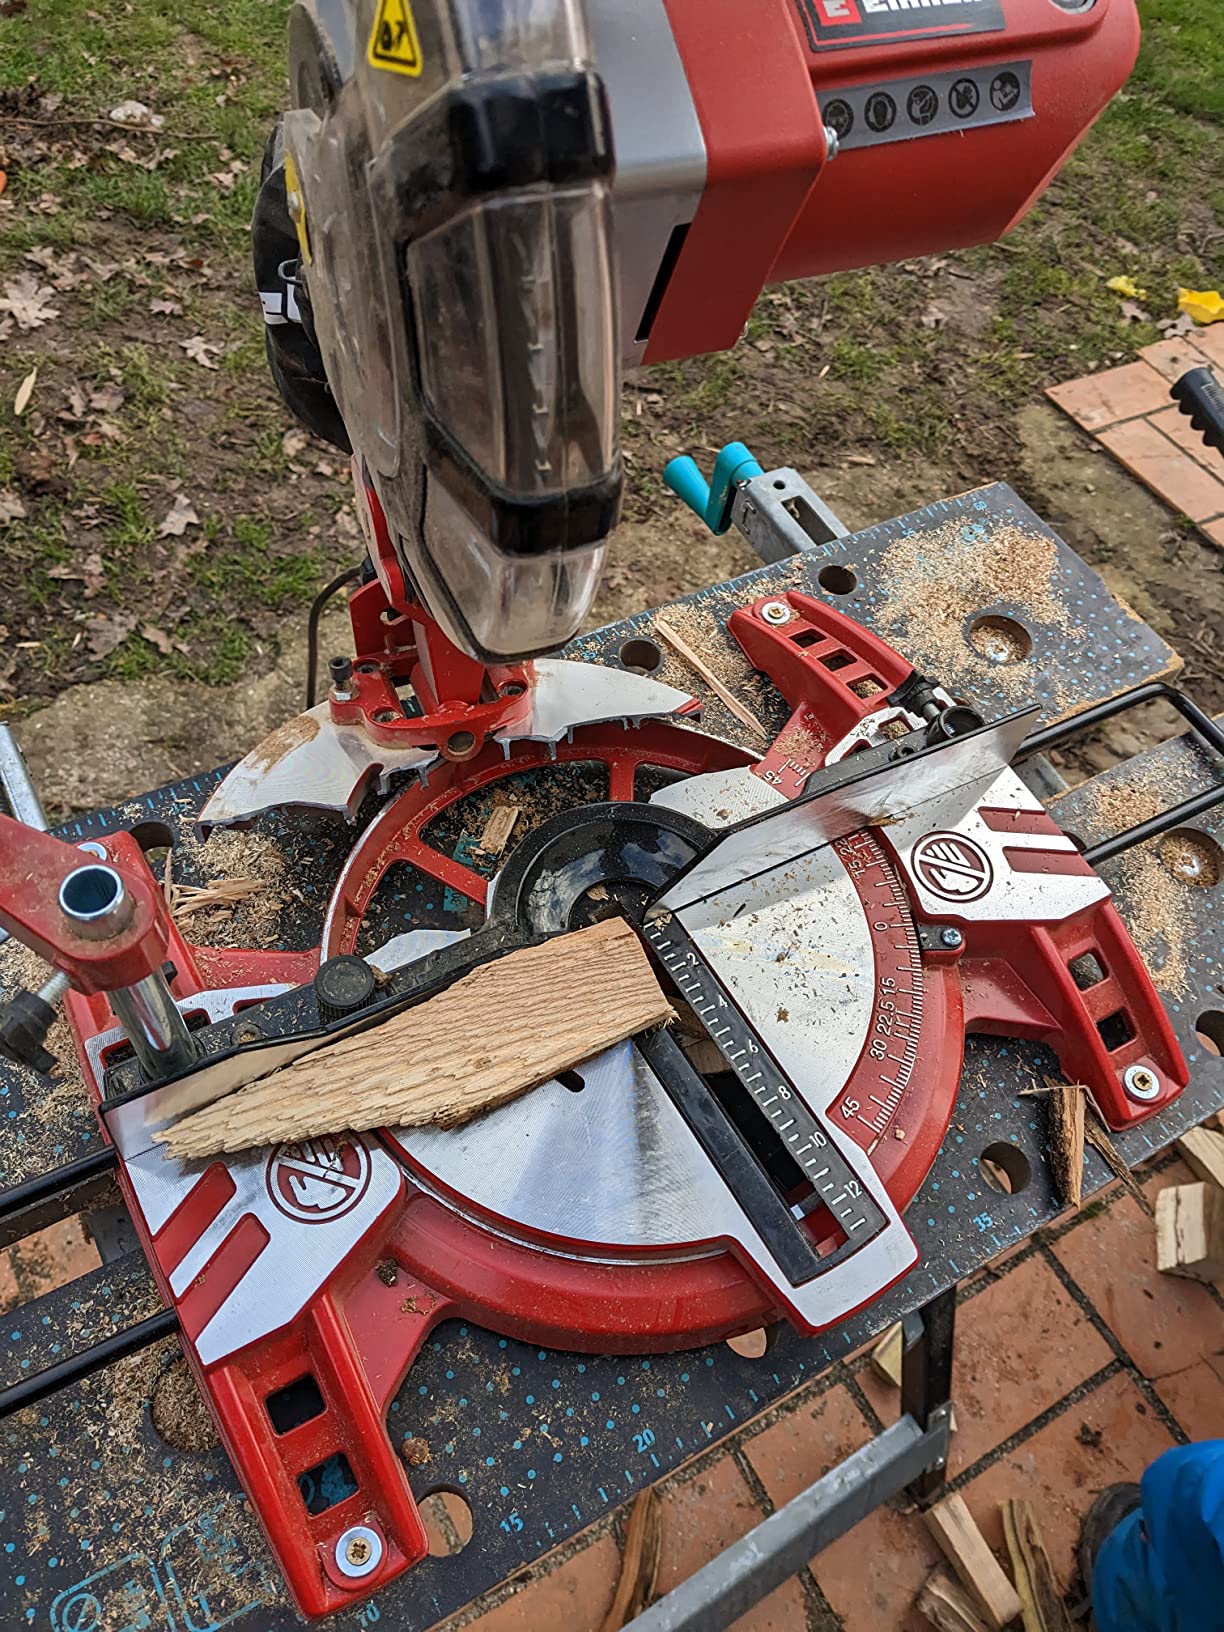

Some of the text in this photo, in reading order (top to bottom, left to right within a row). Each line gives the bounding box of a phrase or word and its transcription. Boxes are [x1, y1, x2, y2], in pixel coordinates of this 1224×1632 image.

[763, 769, 783, 785] 45
[873, 921, 888, 931] 0
[686, 953, 700, 967] 2
[881, 977, 896, 995] 15
[718, 994, 729, 1009] 4
[876, 1001, 896, 1037] 22.5
[748, 1039, 759, 1053] 6
[869, 1039, 888, 1061] 30
[778, 1086, 791, 1100] 8
[840, 1096, 860, 1120] 45
[809, 1132, 827, 1149] 10
[843, 1180, 863, 1199] 12
[972, 1212, 994, 1233] 35
[632, 1428, 656, 1453] 20
[500, 1512, 524, 1533] 15
[355, 1602, 381, 1628] 10
